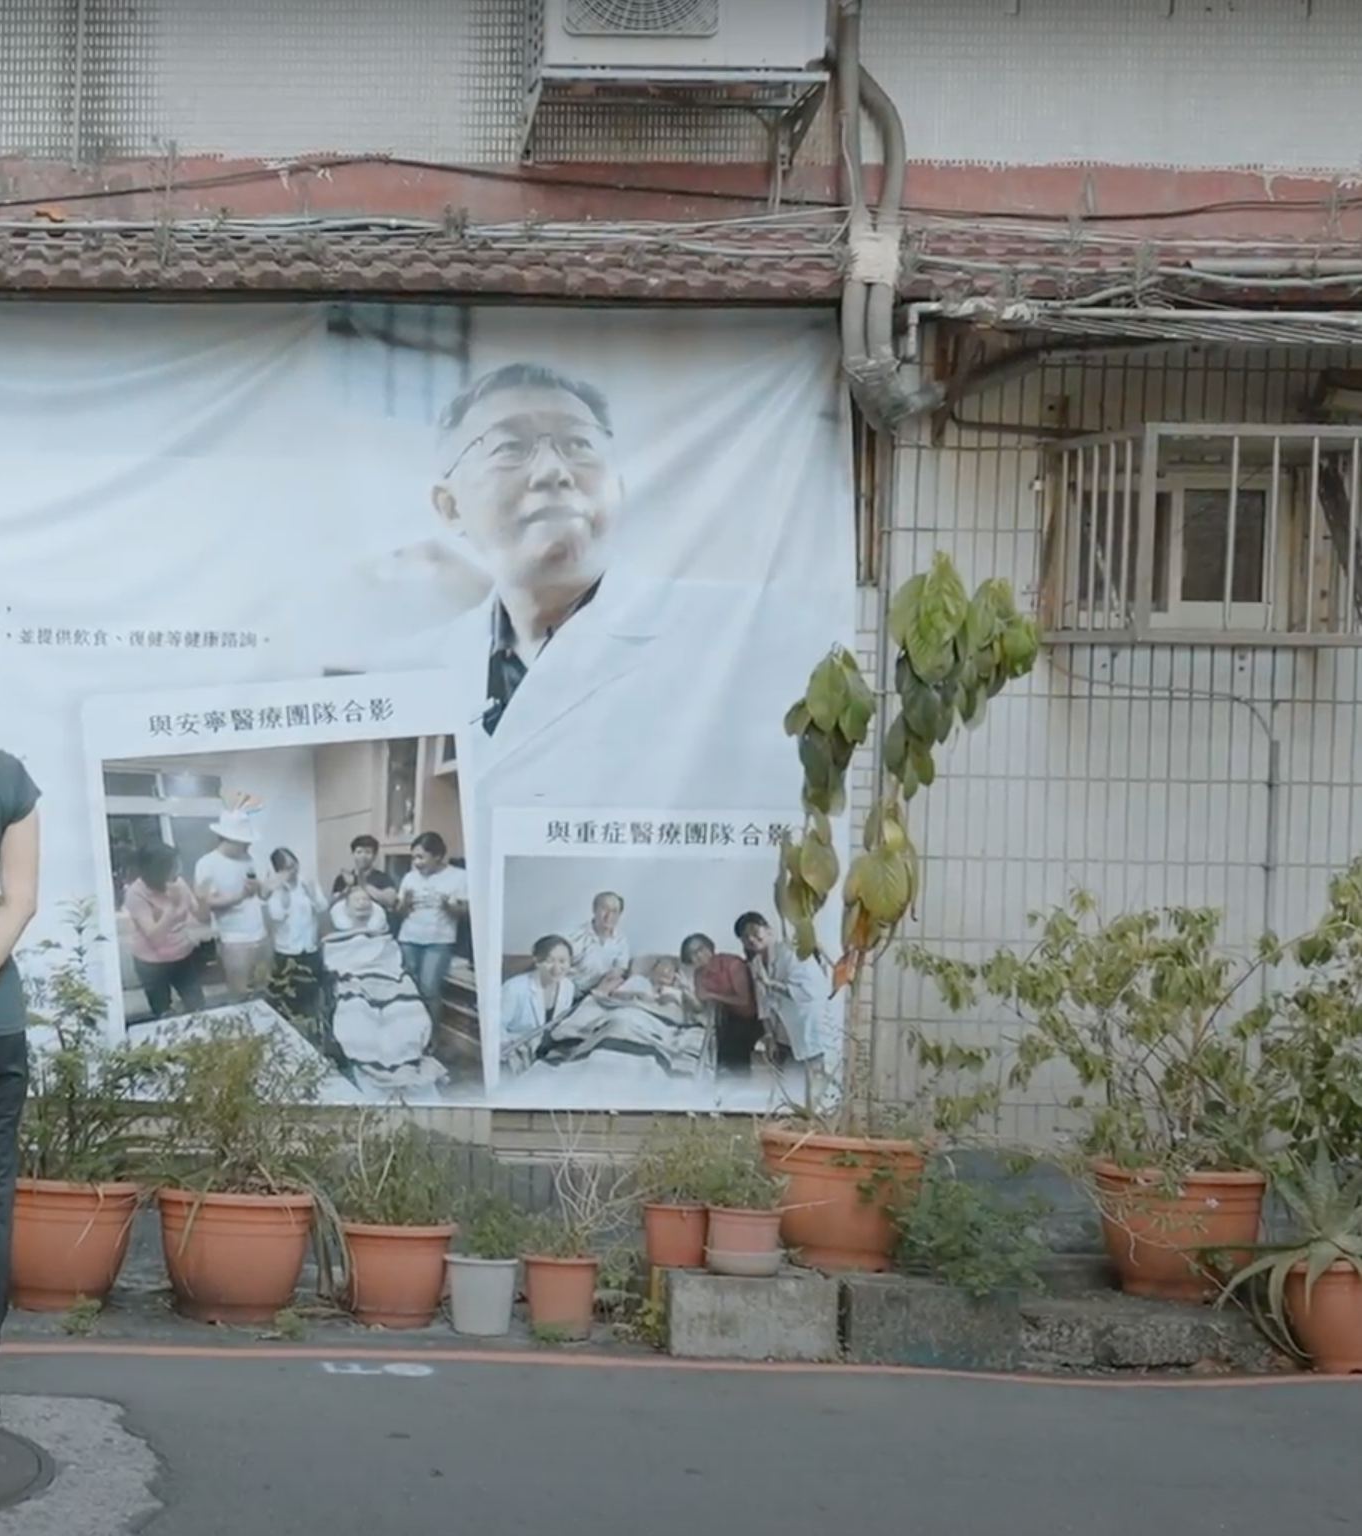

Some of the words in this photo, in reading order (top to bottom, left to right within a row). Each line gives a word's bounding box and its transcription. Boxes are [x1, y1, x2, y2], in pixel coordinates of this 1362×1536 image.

[148, 697, 394, 737] 與安寧醫療團隊合影
[546, 820, 793, 847] 與重症醫療團隊合影
